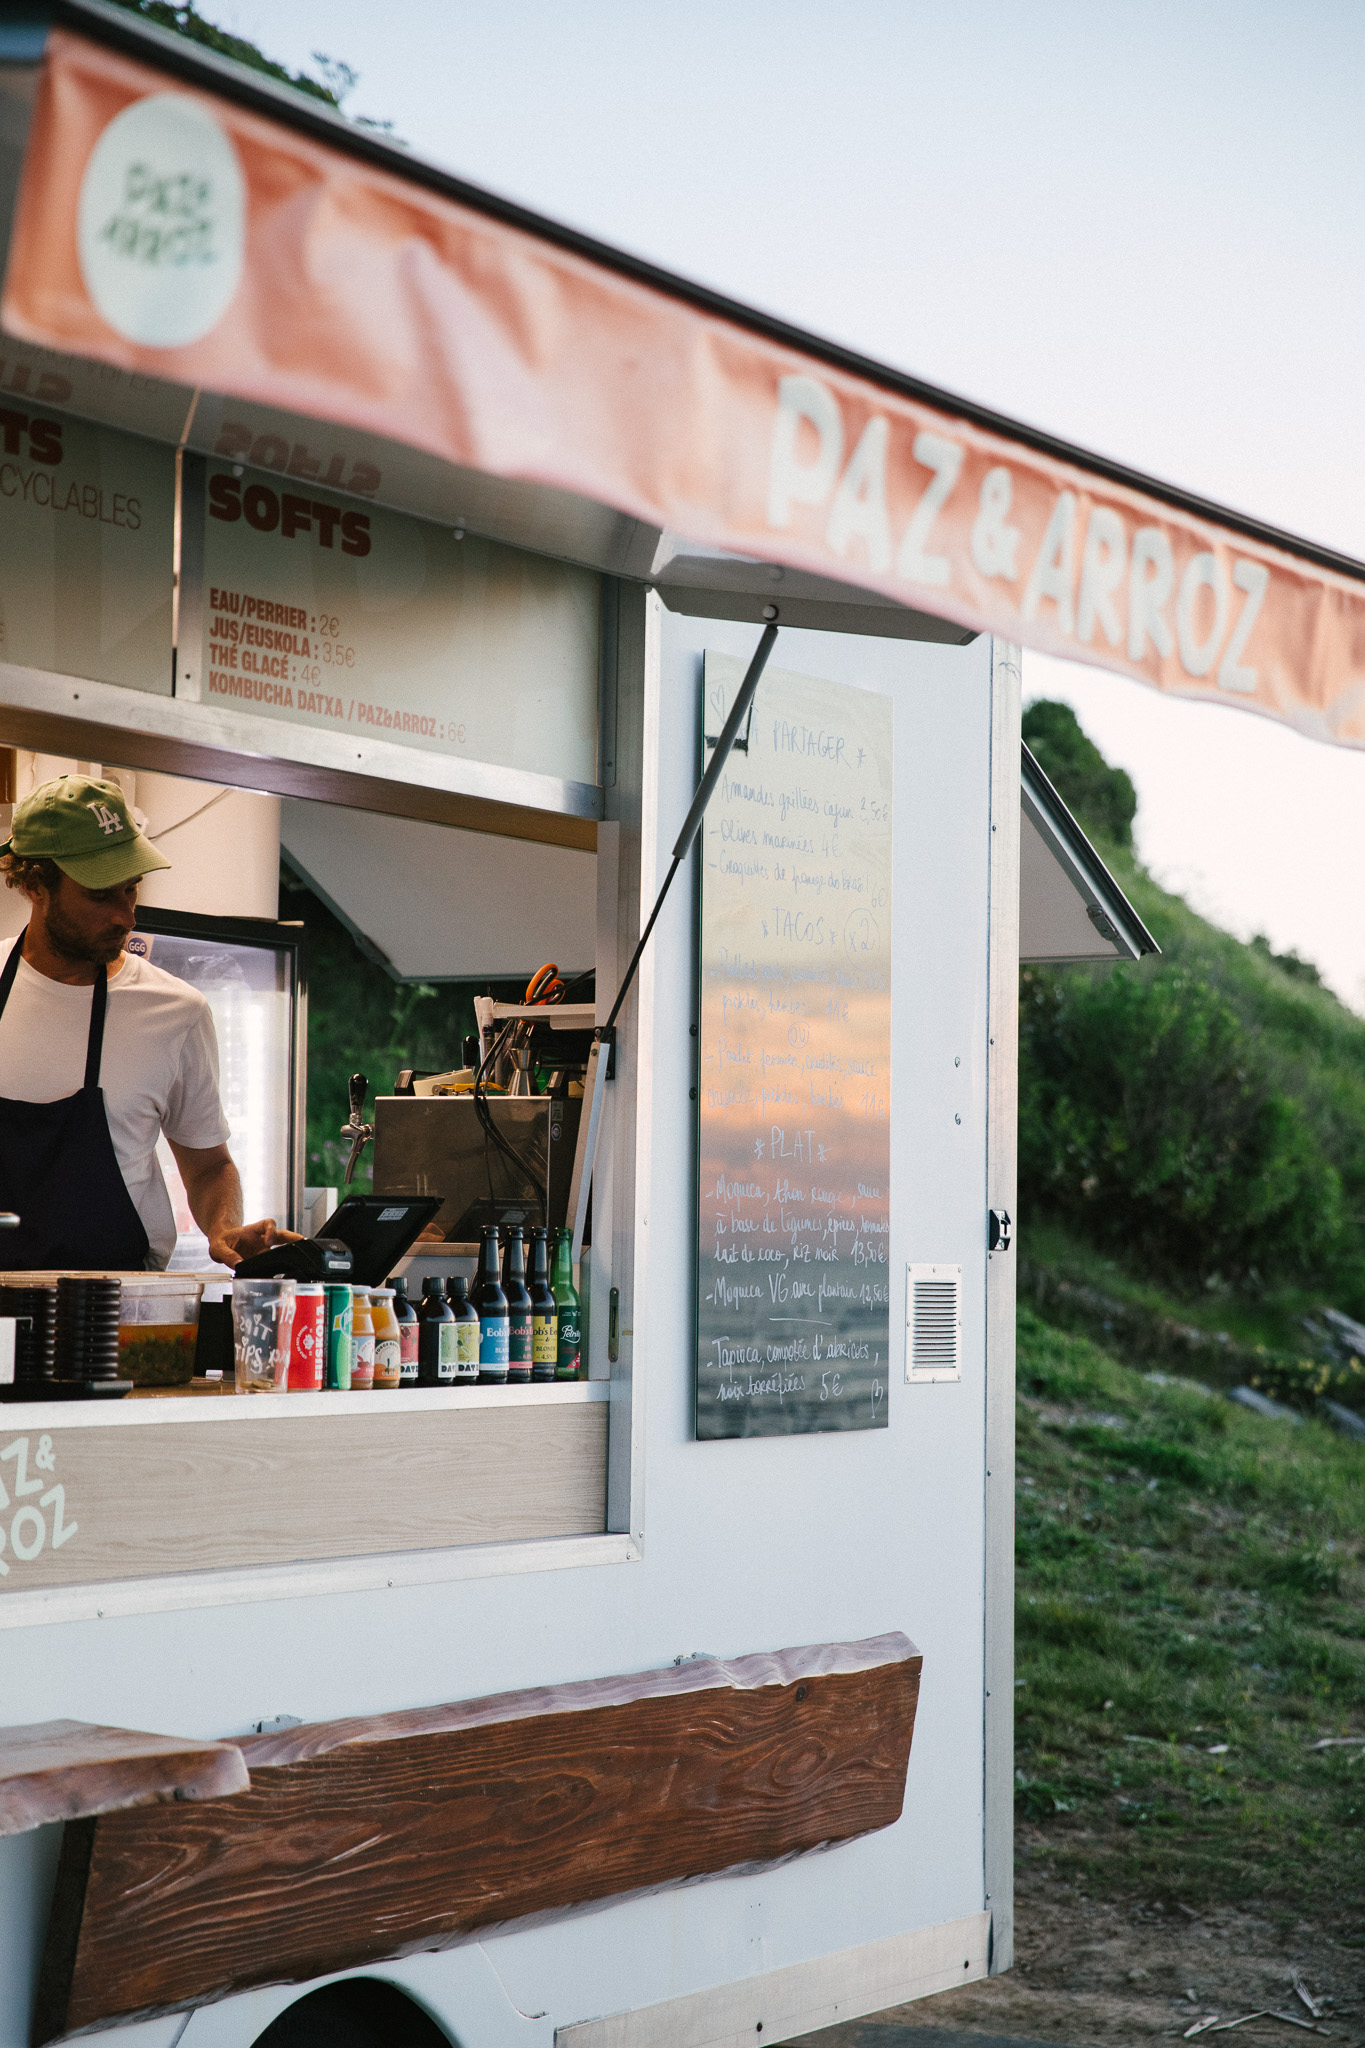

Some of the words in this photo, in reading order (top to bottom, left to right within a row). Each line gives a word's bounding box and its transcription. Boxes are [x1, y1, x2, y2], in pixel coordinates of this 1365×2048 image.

[208, 473, 371, 557] SOFTS
[767, 376, 966, 586] PAZ
[1023, 490, 1270, 693] ARROZ
[319, 613, 339, 638] 2€
[209, 643, 238, 669] THÉ
[241, 650, 289, 680] GLACÉ
[300, 665, 321, 687] 4€
[209, 671, 293, 710] KOMBUCHA
[297, 689, 344, 719] DATXA
[773, 720, 853, 769] PARTAGER
[721, 773, 775, 807] Amandes
[86, 802, 124, 836] LA
[720, 819, 757, 845] Olives
[770, 1125, 816, 1163] PLAT
[773, 1178, 806, 1203] thon
[731, 1209, 759, 1234] base
[762, 1212, 777, 1233] de
[713, 1240, 740, 1264] lait
[741, 1243, 755, 1262] de
[713, 1275, 764, 1311] Moqueca
[314, 1303, 325, 1380] EUSKOLA
[533, 1326, 548, 1336] ob's
[716, 1381, 744, 1402] noix
[819, 1370, 844, 1401] 5€
